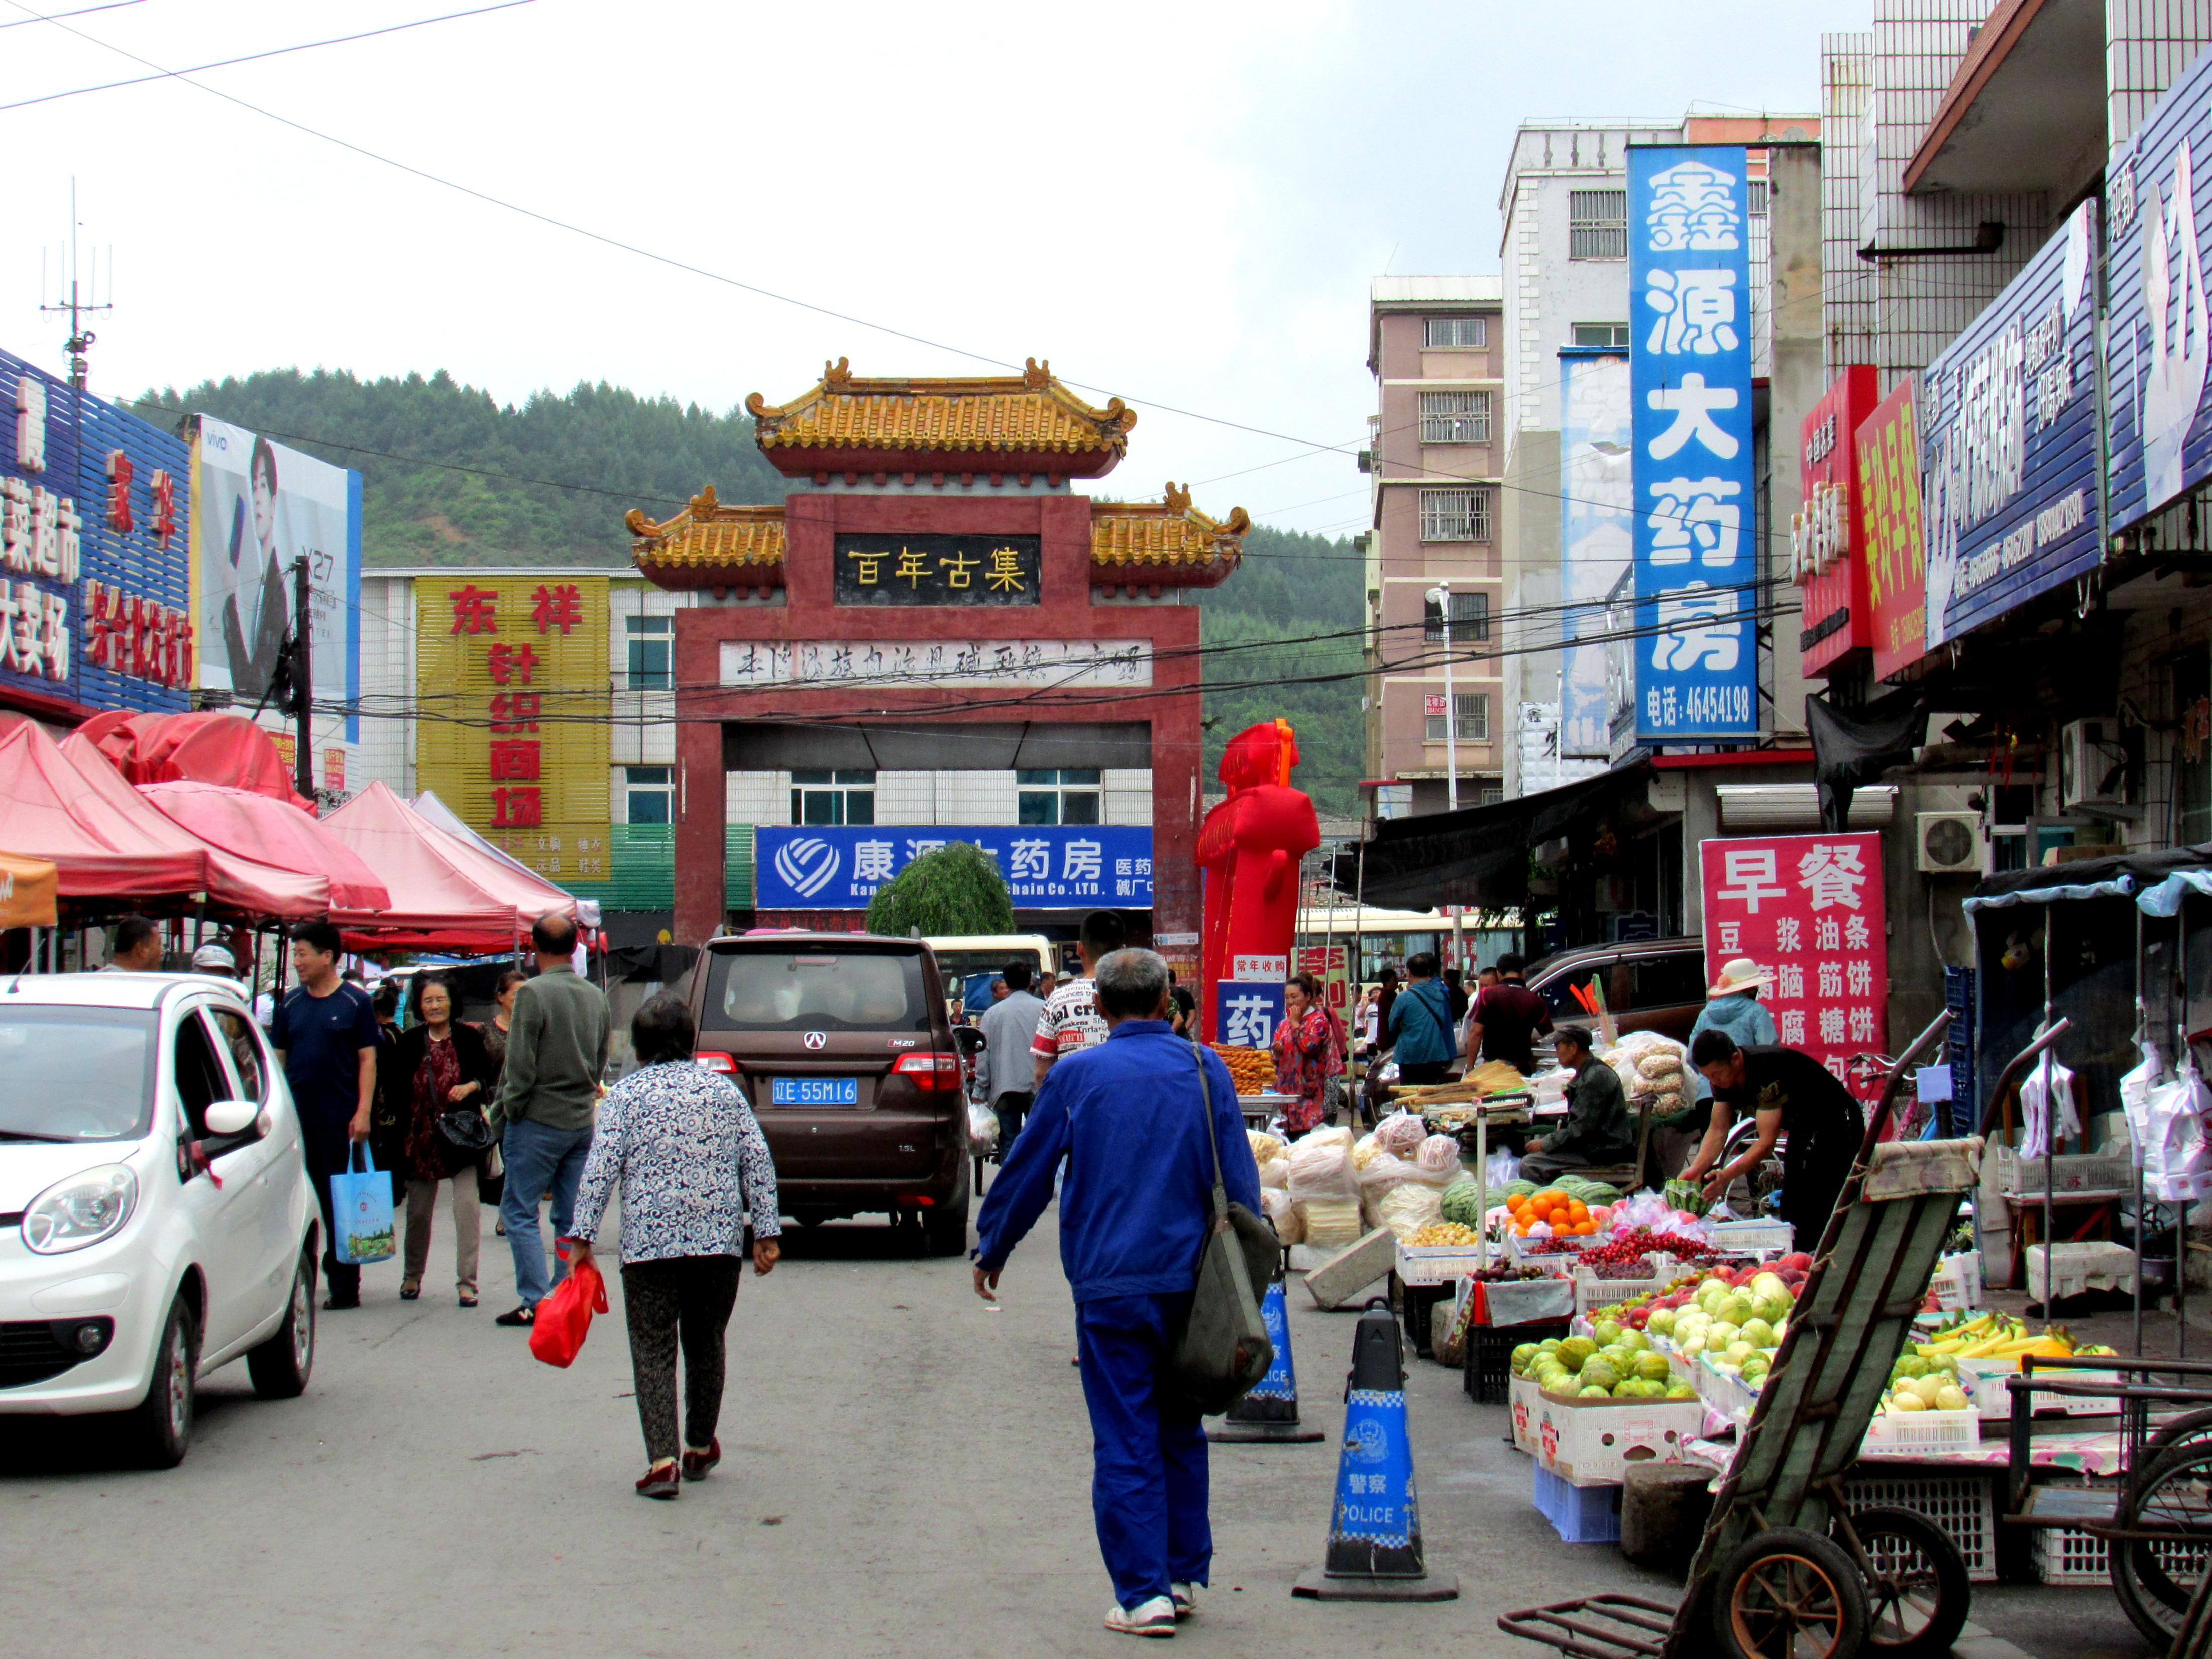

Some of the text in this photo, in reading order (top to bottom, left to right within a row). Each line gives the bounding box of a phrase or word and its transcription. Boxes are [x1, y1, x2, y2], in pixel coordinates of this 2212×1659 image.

[1646, 161, 1742, 671] 鑫源大药房
[207, 430, 227, 451] vivo
[848, 547, 1025, 592] 百年古集
[449, 584, 582, 634] 东祥
[488, 642, 541, 829] 针织商场
[853, 838, 1102, 880] 康药房
[1717, 844, 1866, 914] 早餐
[1815, 914, 1869, 951] 油条
[1237, 959, 1285, 973] 常年收购
[1818, 960, 1872, 997] 筋饼
[1226, 995, 1274, 1049] 药
[1819, 1006, 1874, 1044] 糖饼
[1349, 1474, 1387, 1494] 警察
[1340, 1505, 1393, 1524] POLICE
